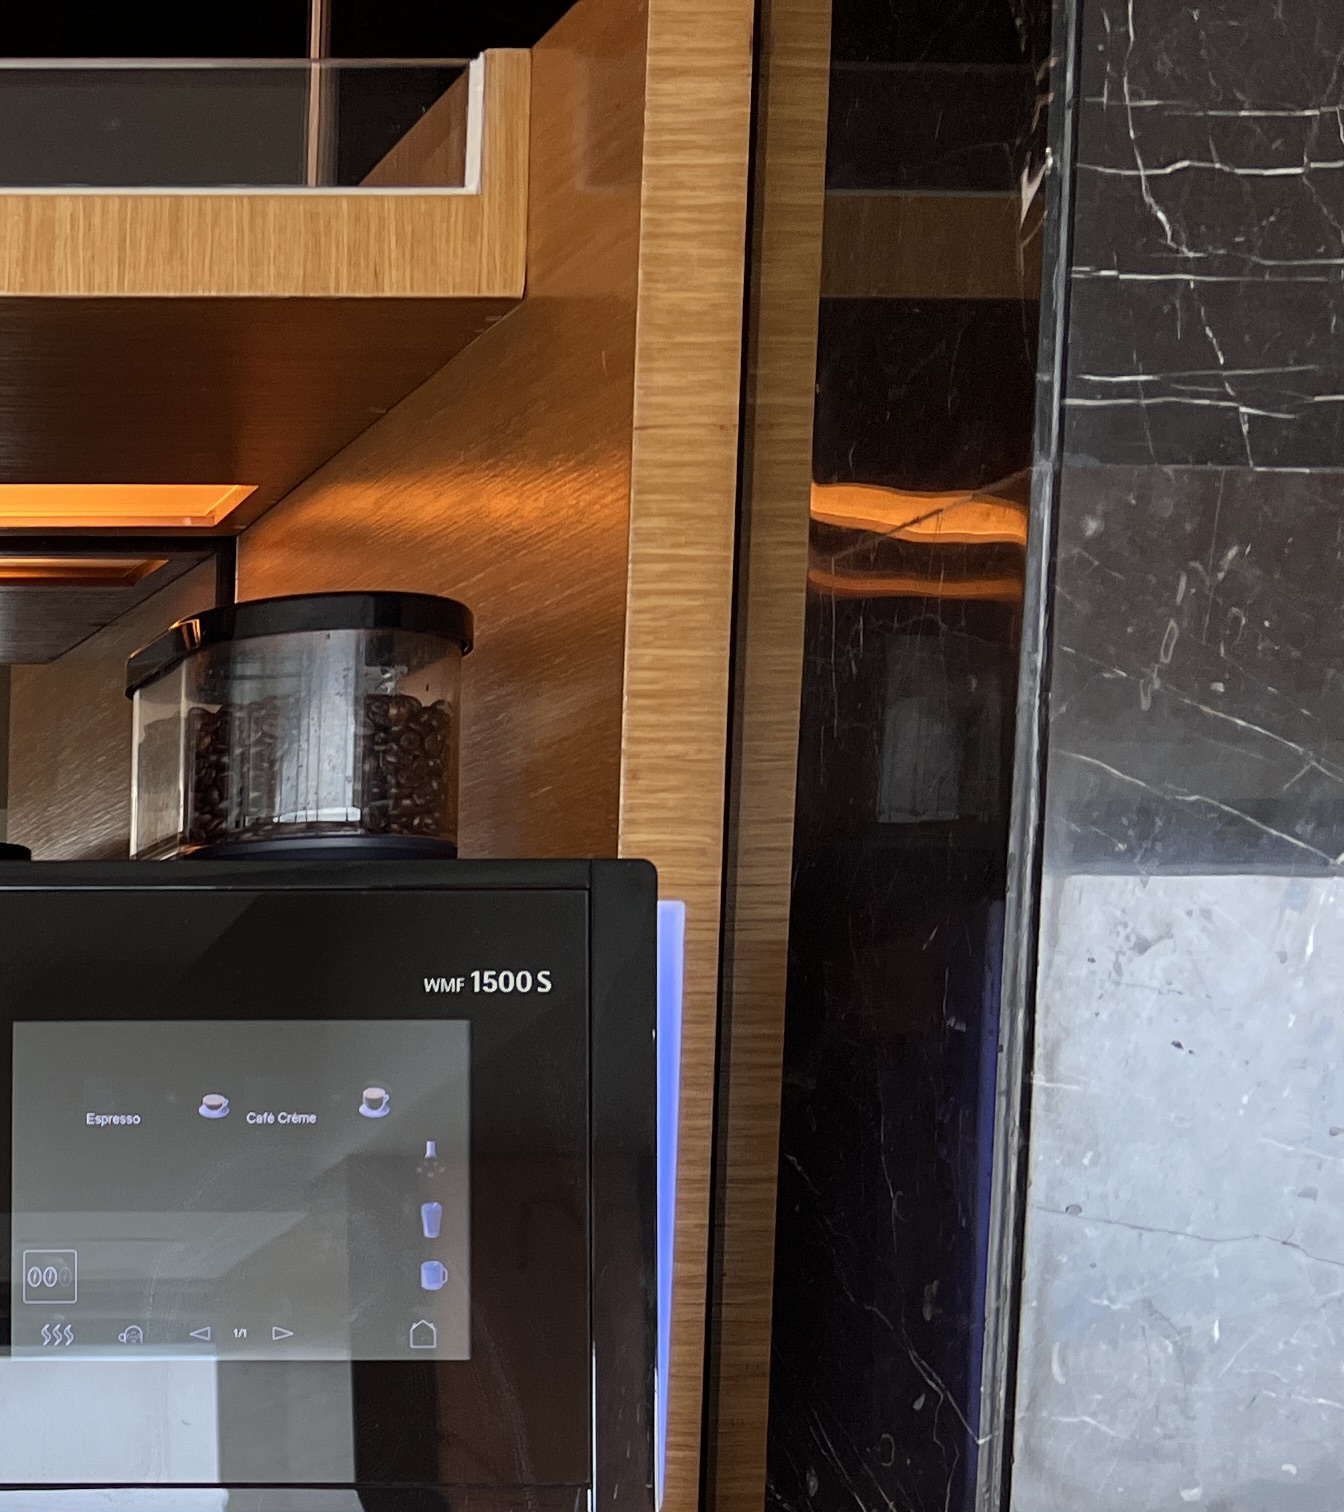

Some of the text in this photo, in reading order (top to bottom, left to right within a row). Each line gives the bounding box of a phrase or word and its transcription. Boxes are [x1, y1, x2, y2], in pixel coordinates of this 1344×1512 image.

[424, 970, 552, 993] WMF 1500 S
[86, 1113, 141, 1126] Espresso
[246, 1111, 275, 1124] Café
[233, 1328, 248, 1338] 1/1
